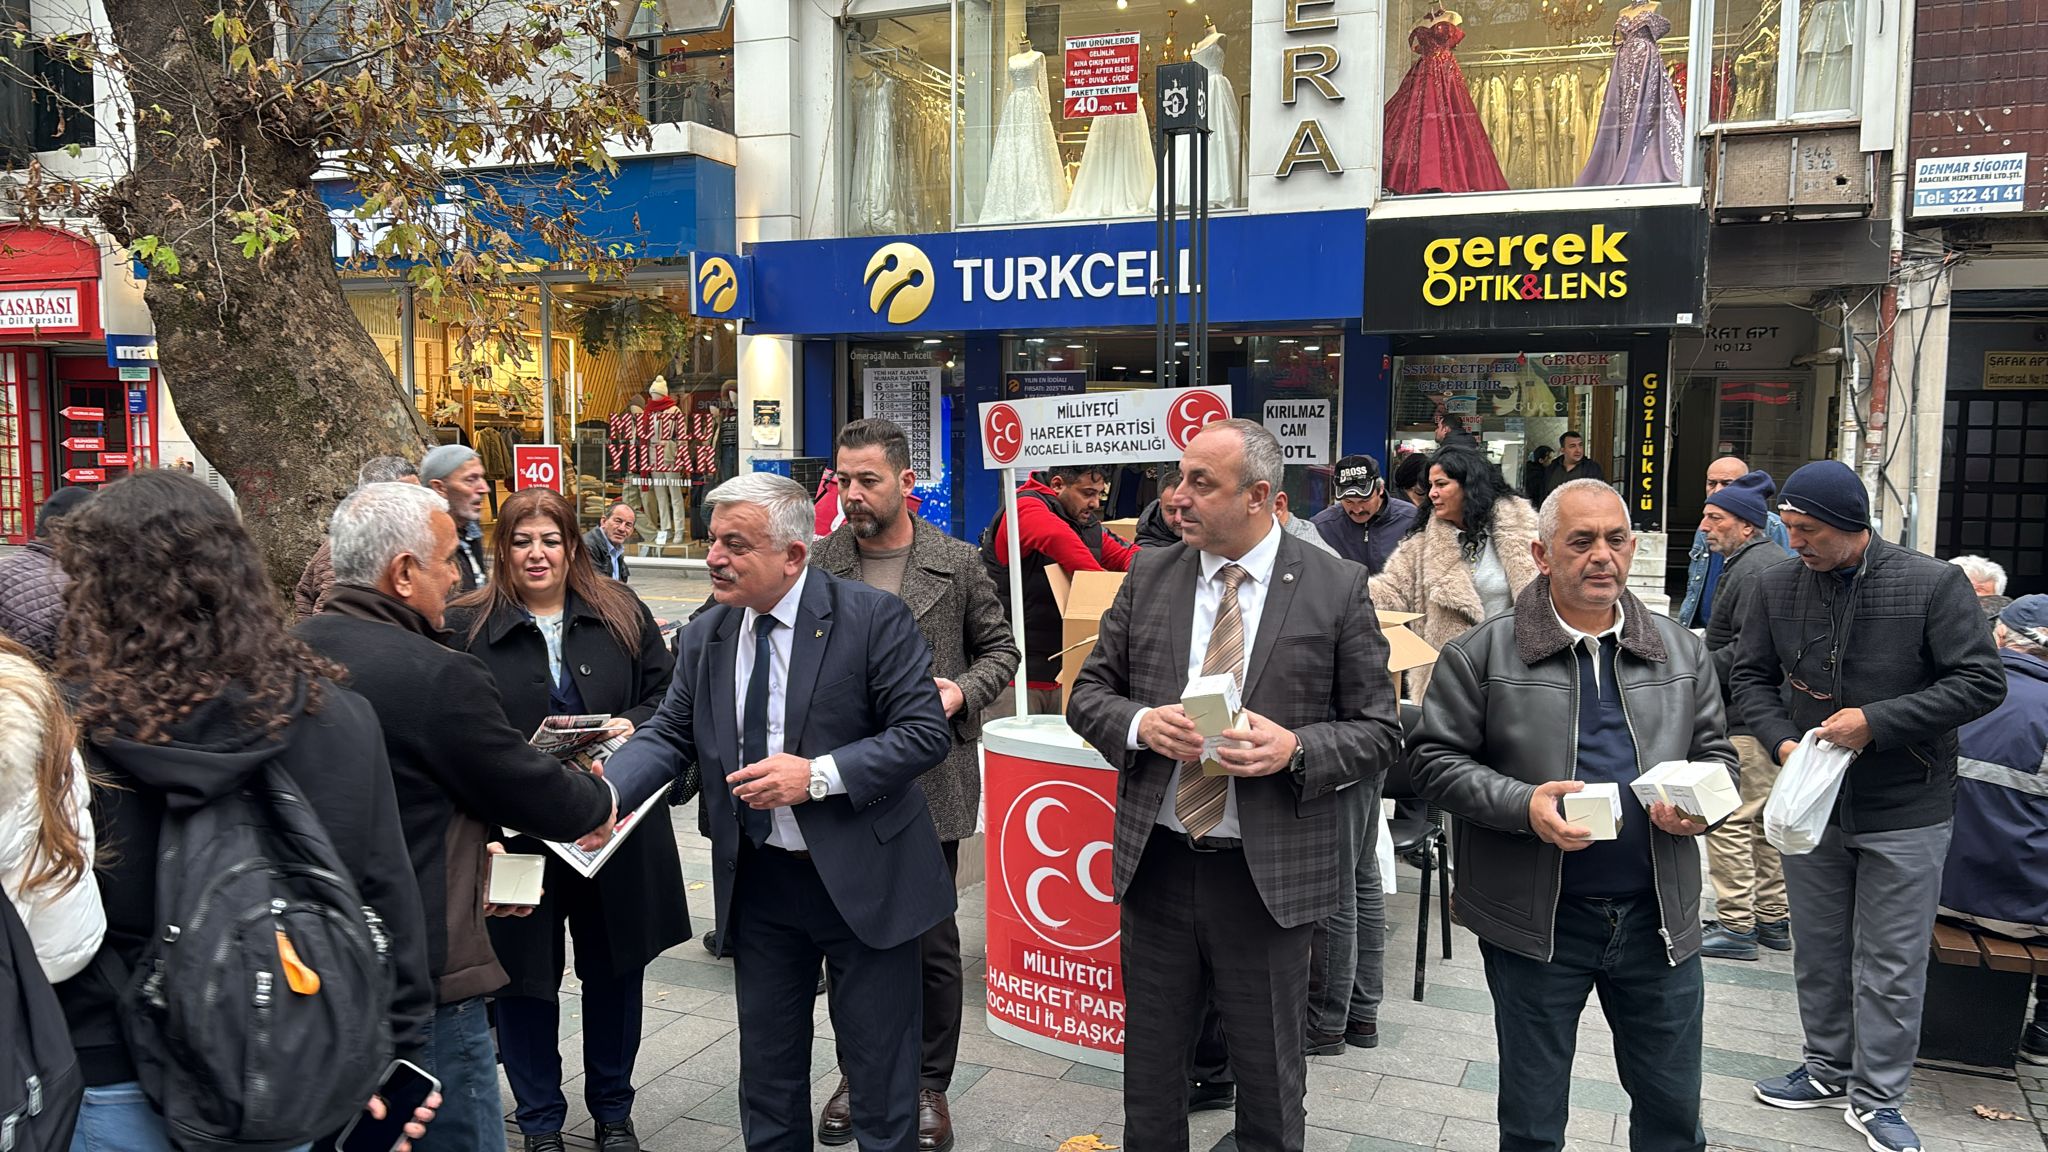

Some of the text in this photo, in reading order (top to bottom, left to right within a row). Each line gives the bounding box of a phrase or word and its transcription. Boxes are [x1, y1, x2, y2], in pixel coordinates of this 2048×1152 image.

[1089, 36, 1136, 47] ÜRÜNLERDE
[1089, 49, 1115, 58] GELİNLİK
[1095, 67, 1114, 75] AFTER
[1088, 76, 1108, 84] DUVAK
[1071, 89, 1094, 97] PAKET
[1111, 86, 1132, 94] FİYAT
[1115, 102, 1128, 110] TL
[1919, 158, 2023, 176] DENMAR SİGORTA
[1918, 175, 1950, 183] ARACILIK
[1951, 173, 1992, 182] HİZMETLERİ
[1917, 186, 2021, 205] Tel: 322 41 41
[1424, 224, 1629, 275] gerçek
[953, 248, 1201, 302] TURKCELL
[9, 317, 24, 325] Dil
[29, 316, 73, 325] Kursları
[1745, 326, 1779, 339] APT
[1714, 343, 1752, 352] NO 123
[850, 351, 933, 361] Ömerağa Mah. Turkcell
[1542, 354, 1609, 366] GERÇEK
[1403, 365, 1428, 376] SSK
[875, 382, 883, 391] 6
[873, 392, 885, 401] 12
[873, 402, 885, 411] 18
[1057, 398, 1119, 420] MİLLİYETÇİ
[1266, 405, 1325, 419] KIRILMAZ
[609, 412, 715, 441] MUTLU
[1030, 417, 1155, 441] HAREKET PARTİSİ
[1280, 423, 1307, 437] CAM
[1024, 436, 1165, 456] KOCAELİ İL BAŞKANLIĞI
[1641, 373, 1658, 511] Gözlükçü
[608, 444, 717, 473] YILLAR
[1023, 950, 1113, 992] MİLLİYETÇİ
[989, 965, 1074, 1009] HAREKET
